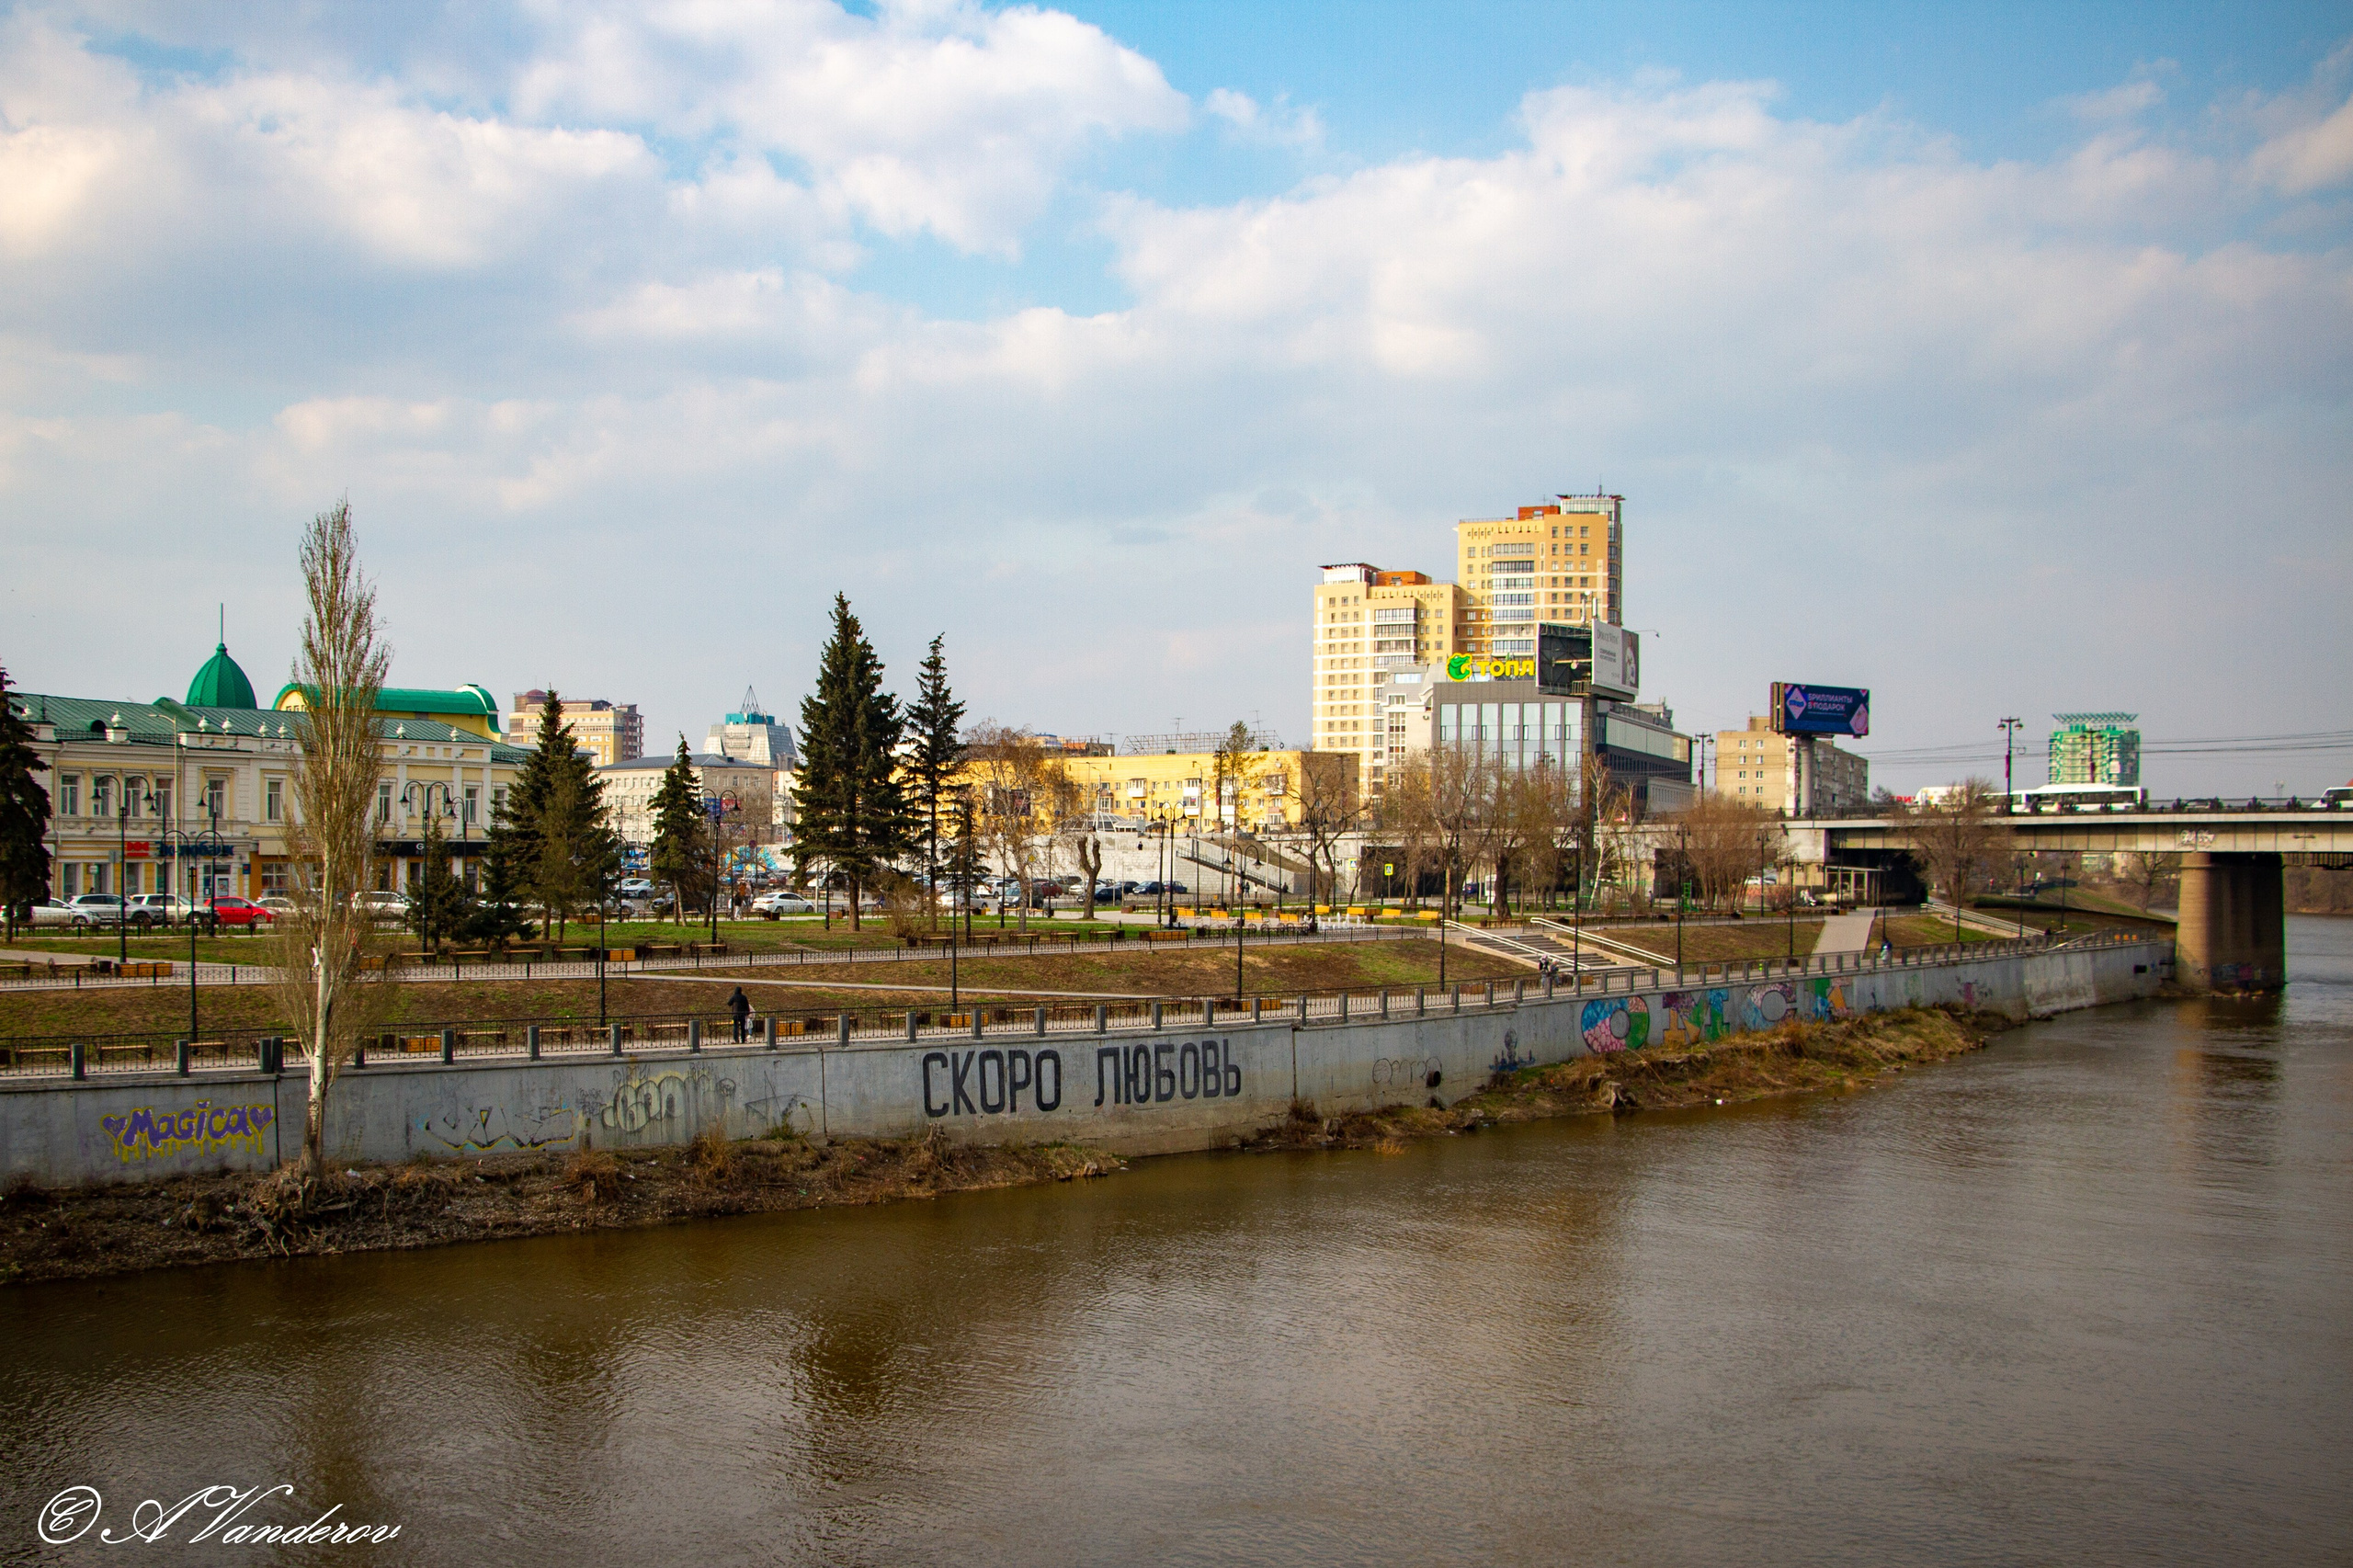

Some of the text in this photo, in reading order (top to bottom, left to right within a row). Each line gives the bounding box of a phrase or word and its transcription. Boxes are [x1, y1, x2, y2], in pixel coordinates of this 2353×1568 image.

[1476, 660, 1536, 676] ТОПЛ
[1808, 693, 1853, 703] БРИЛЛИАНТЫ
[1813, 702, 1846, 711] ПОДАРОК
[922, 1038, 1242, 1119] СКОРО ЛЮБОВЬ
